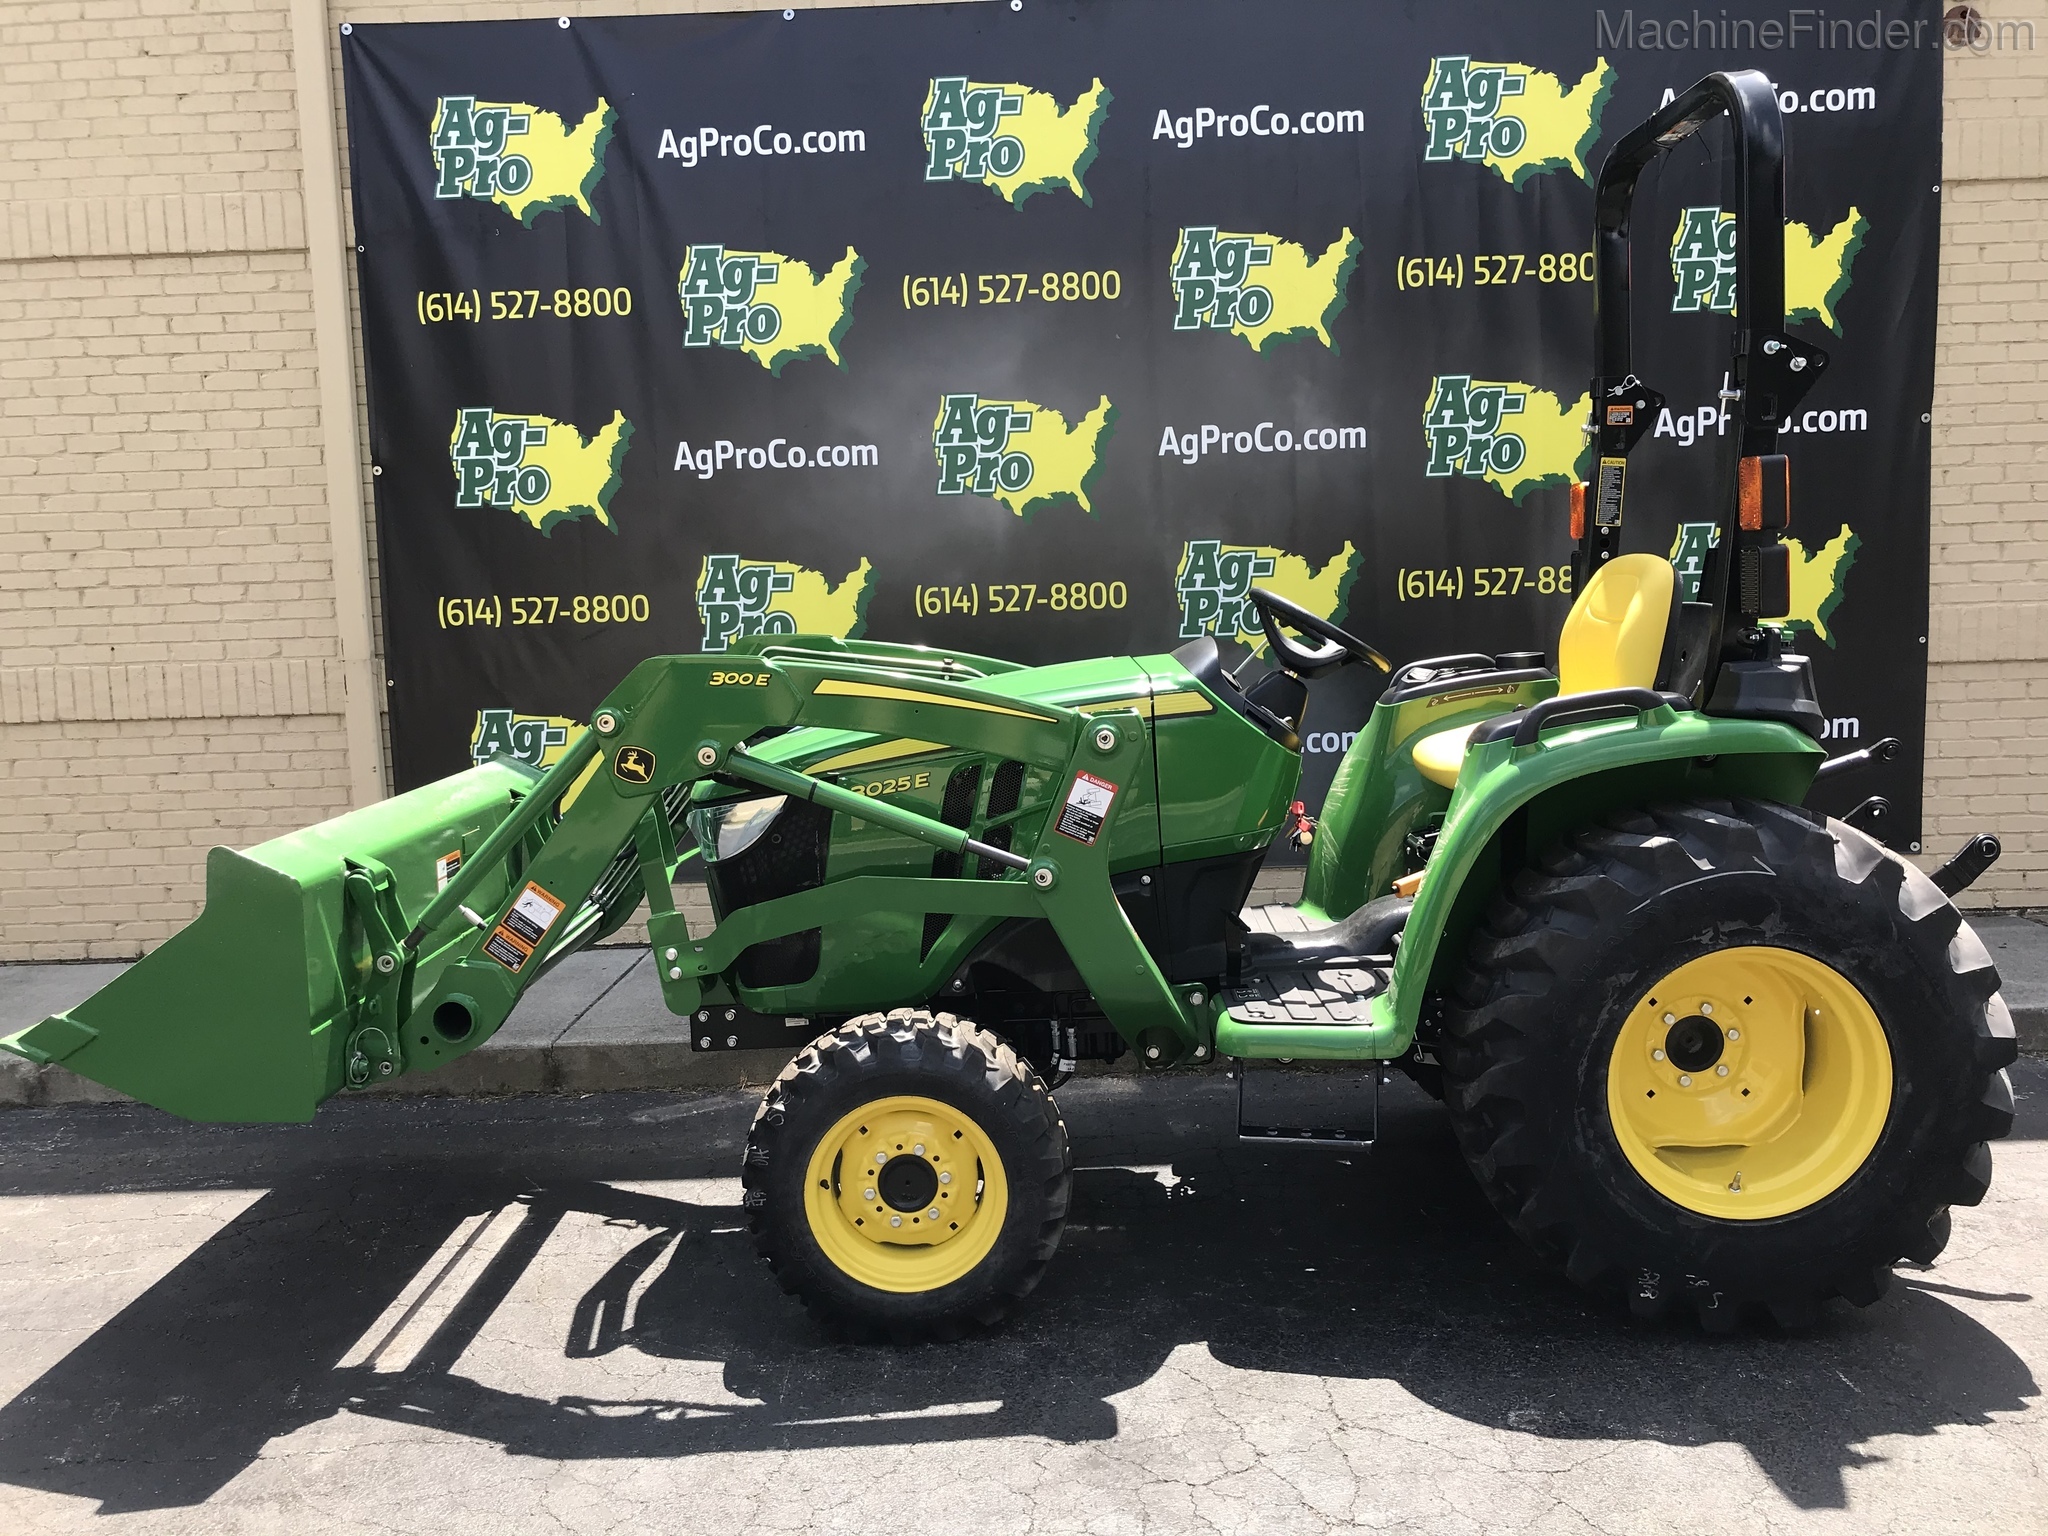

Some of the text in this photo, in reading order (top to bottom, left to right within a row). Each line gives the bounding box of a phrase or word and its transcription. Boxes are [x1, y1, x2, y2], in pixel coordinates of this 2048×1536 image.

[926, 76, 1022, 136] Ag-
[1427, 55, 1527, 113] Ag-
[434, 96, 530, 156] Ag-
[657, 124, 866, 168] AgProCo.com
[1153, 104, 1365, 149] AgProCo.com
[1424, 108, 1525, 163] Pro
[435, 149, 532, 198] Pro
[924, 129, 1024, 180] Pro
[681, 244, 779, 302] Ag-
[1174, 225, 1272, 285] Ag-
[1398, 252, 1594, 291] (614) 527-880
[418, 287, 632, 325] (614) 527-8800
[903, 270, 1121, 309] (614) 527-8800
[1174, 277, 1272, 330] Pro
[1672, 260, 1737, 312] Pr
[683, 297, 781, 347] Pro
[936, 393, 1032, 452] Ag-
[1426, 376, 1524, 434] Ag-
[454, 407, 547, 466] Ag-
[673, 438, 879, 480] AgProCo.com
[1159, 421, 1367, 465] AgProCo.com
[1425, 427, 1526, 477] Pro
[456, 459, 550, 507] Pro
[937, 446, 1034, 495] Pro
[699, 555, 793, 615] Ag-
[1178, 540, 1274, 600] Ag-
[1398, 565, 1572, 602] (614) 527-88
[438, 594, 650, 629] (614) 527-8800
[915, 581, 1127, 618] (614) 527-8800
[1179, 588, 1266, 638] Pro
[1089, 776, 1113, 791] DANGER
[536, 889, 561, 908] WARNING
[505, 933, 529, 953] WARNING
